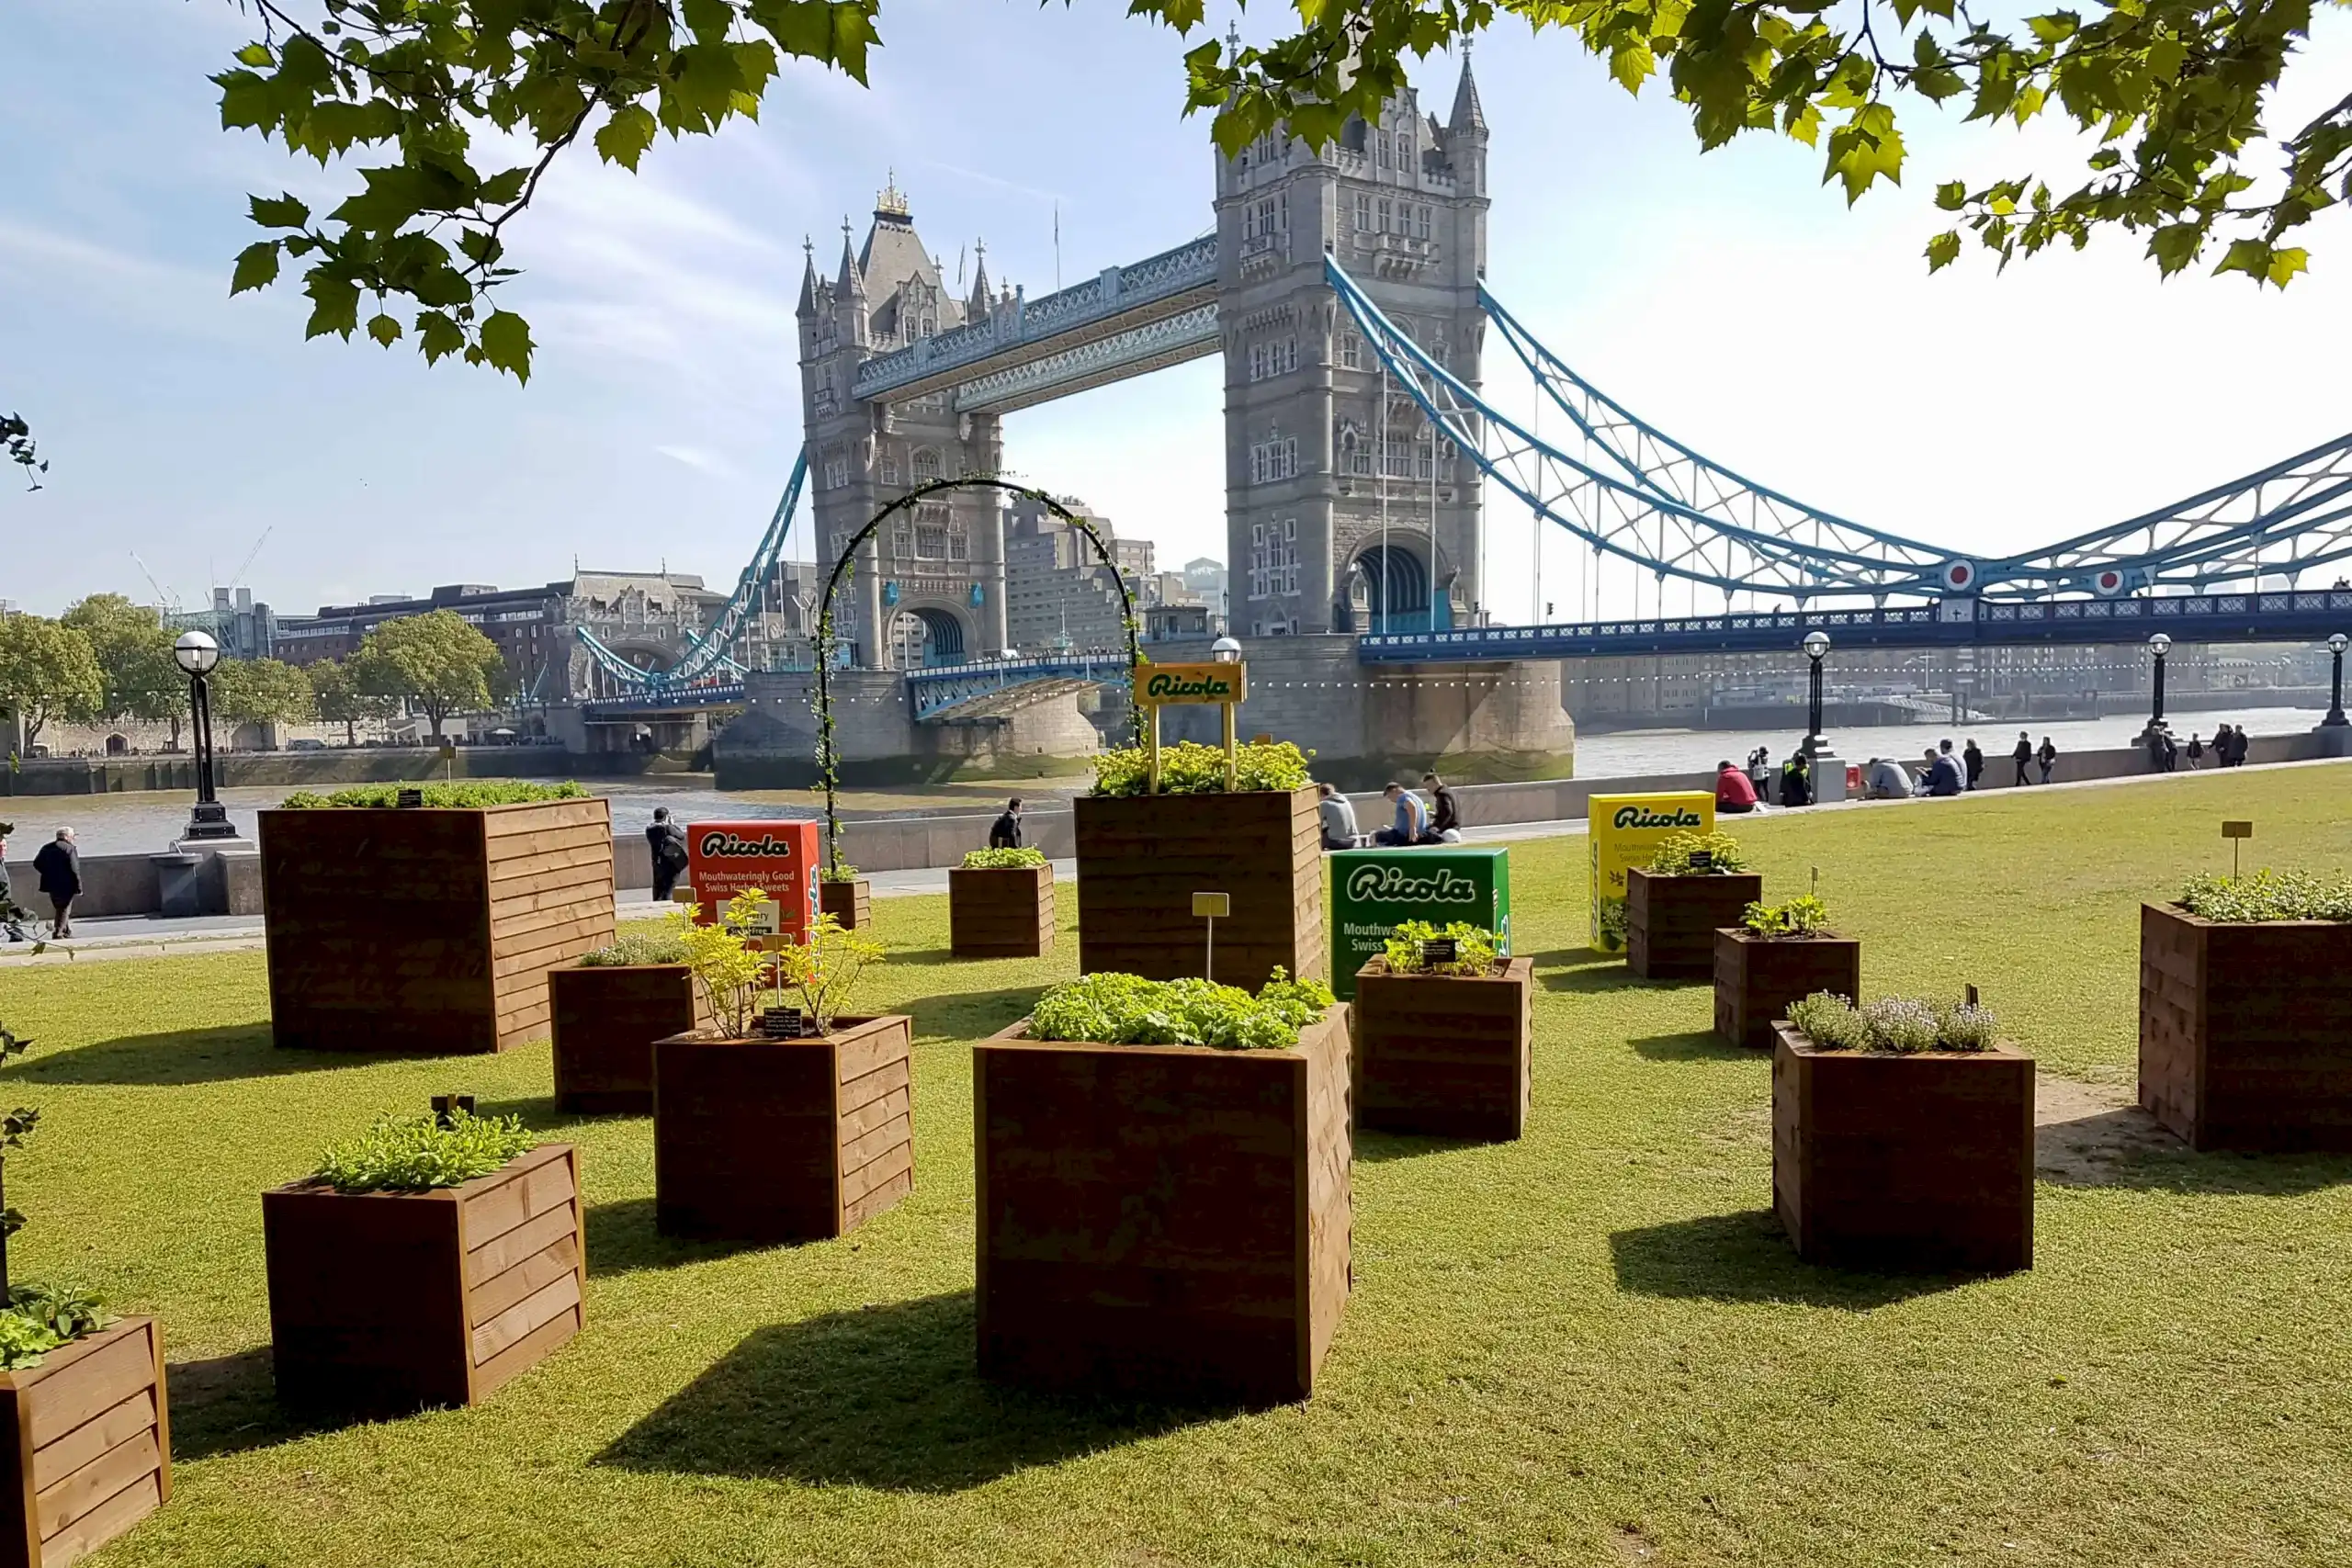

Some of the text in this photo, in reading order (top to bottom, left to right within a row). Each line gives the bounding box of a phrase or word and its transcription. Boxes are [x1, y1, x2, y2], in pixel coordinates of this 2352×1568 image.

[1148, 673, 1229, 696] Ricola
[1613, 805, 1702, 829] Ricola
[700, 831, 790, 858] Ricola
[699, 871, 795, 883] Mouthwateringly Good
[706, 883, 729, 892] Swiss
[760, 883, 790, 892] Sweets
[1347, 864, 1476, 903] Ricola
[1351, 938, 1384, 952] Swiss
